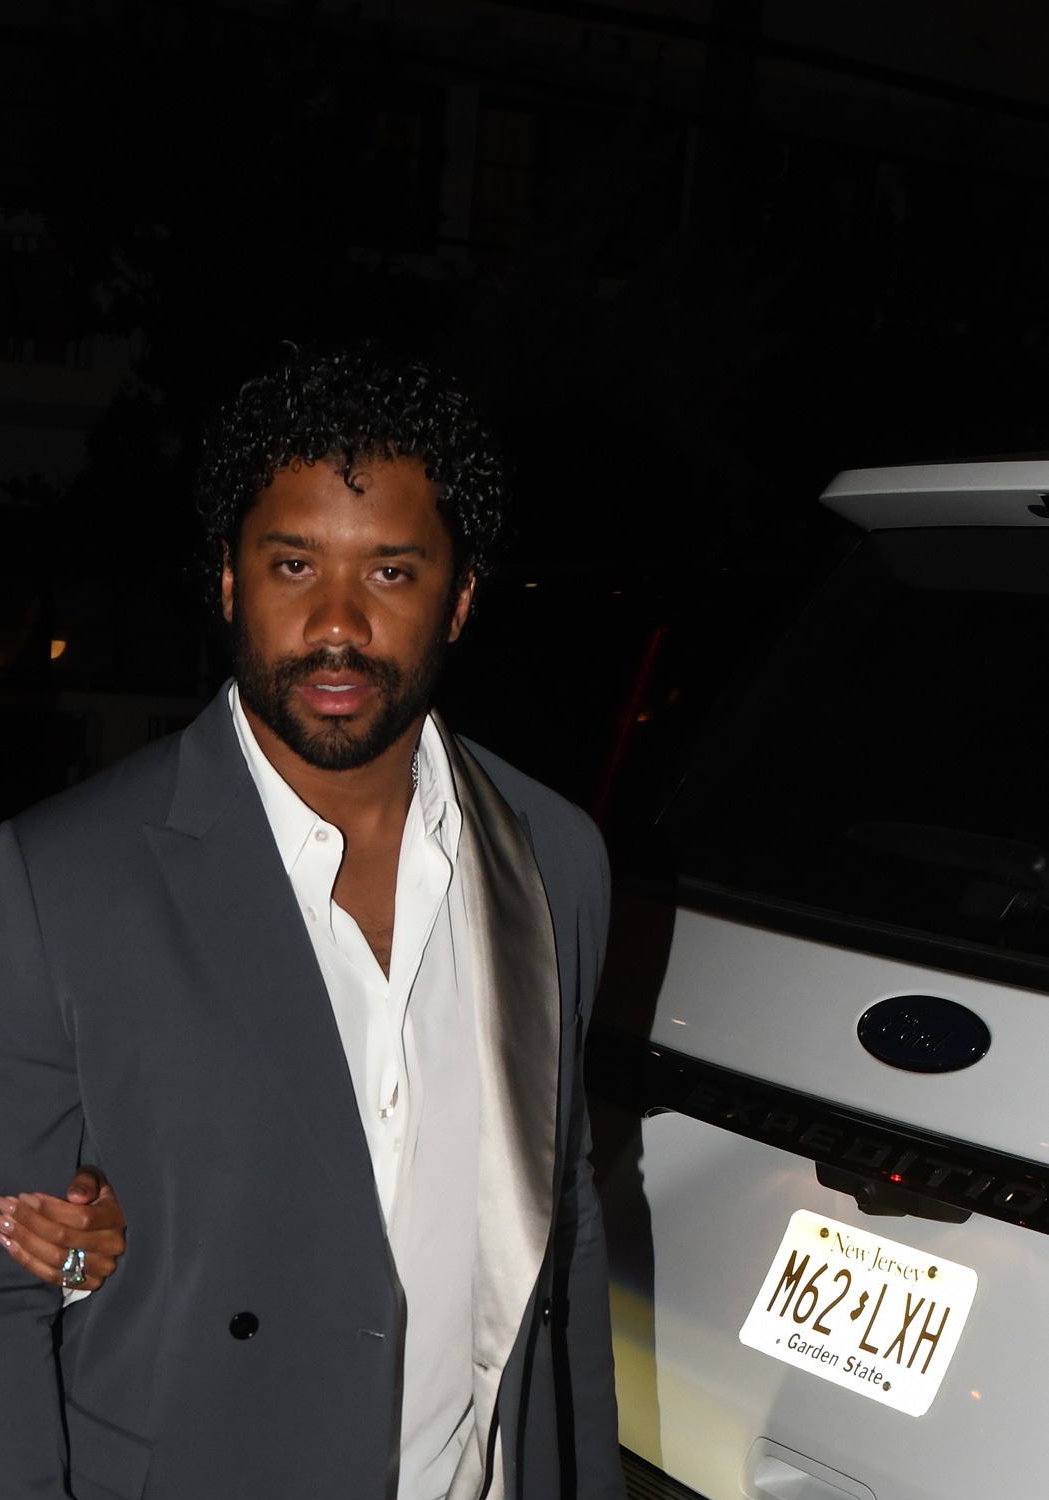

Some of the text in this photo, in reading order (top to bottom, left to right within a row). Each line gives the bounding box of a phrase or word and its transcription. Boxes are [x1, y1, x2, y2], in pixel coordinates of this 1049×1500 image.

[684, 1084, 1048, 1217] EXPEDITIO
[831, 1232, 924, 1286] New Jersey
[766, 1249, 951, 1375] M62 LXH
[787, 1333, 883, 1385] Garden State
